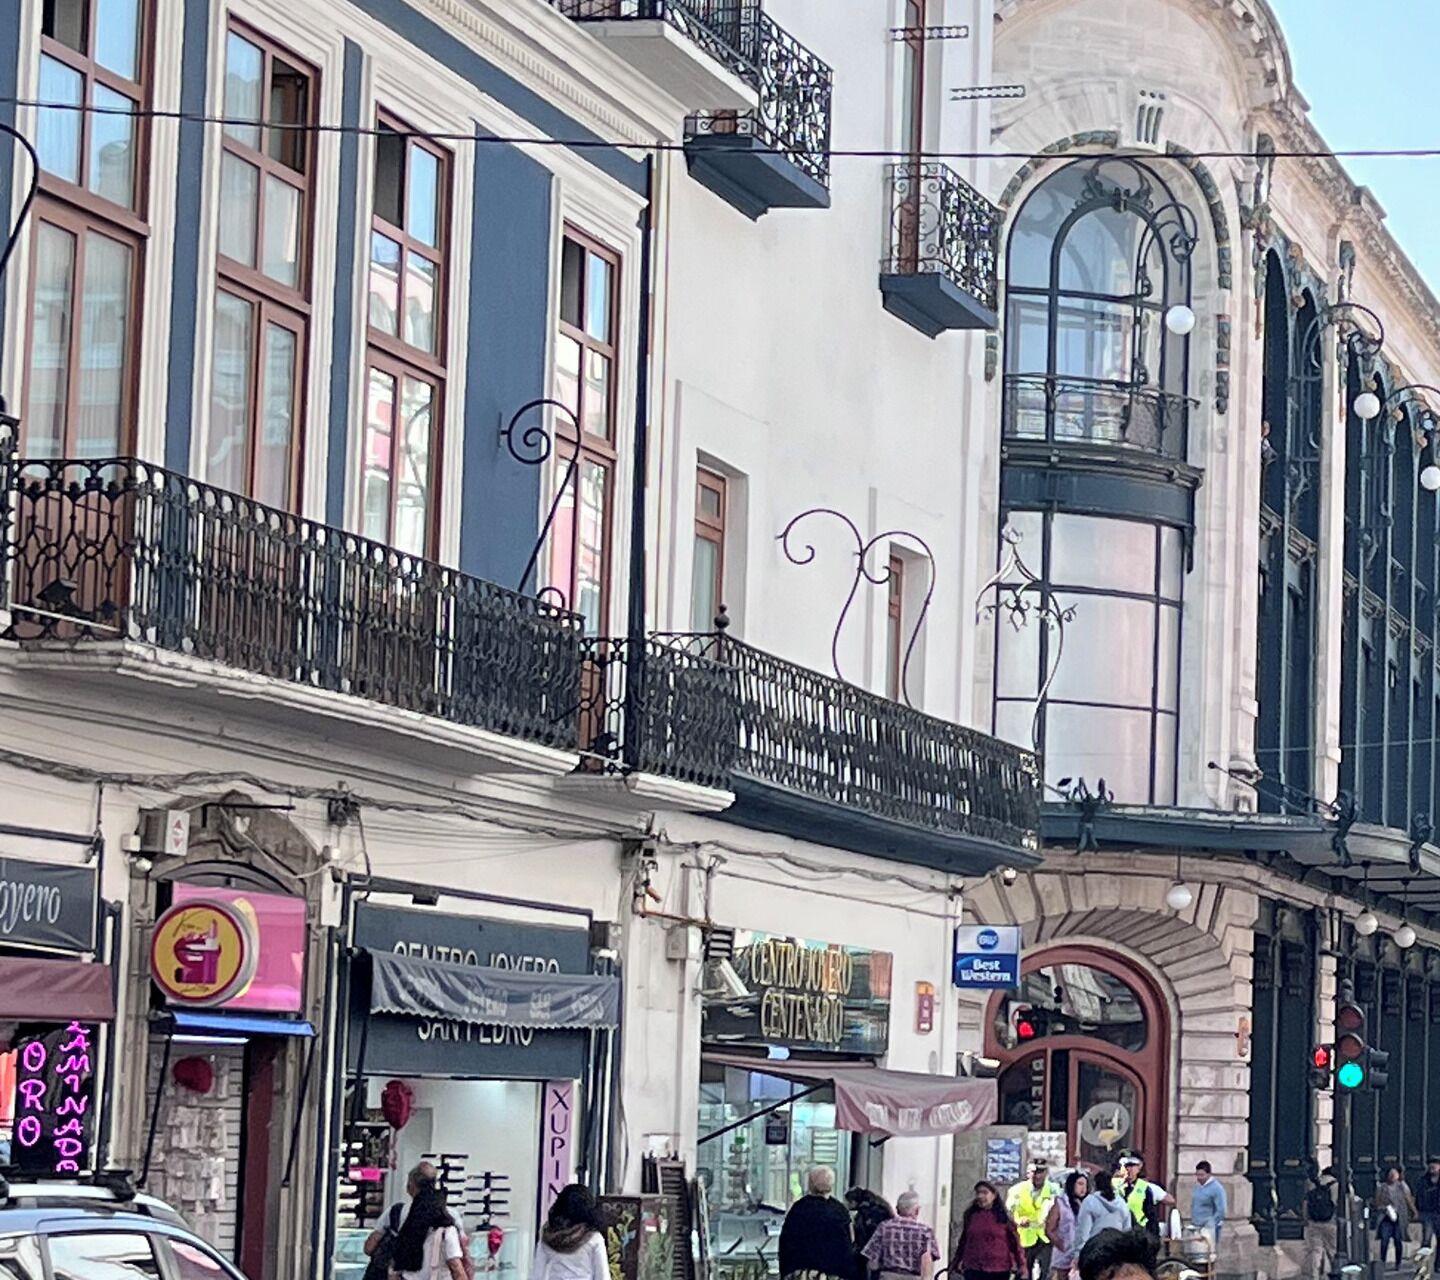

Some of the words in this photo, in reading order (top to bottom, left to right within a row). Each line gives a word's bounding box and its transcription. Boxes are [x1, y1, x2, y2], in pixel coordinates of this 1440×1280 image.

[972, 959, 1001, 971] Best
[960, 969, 1011, 982] Western
[18, 1041, 47, 1147] ORO
